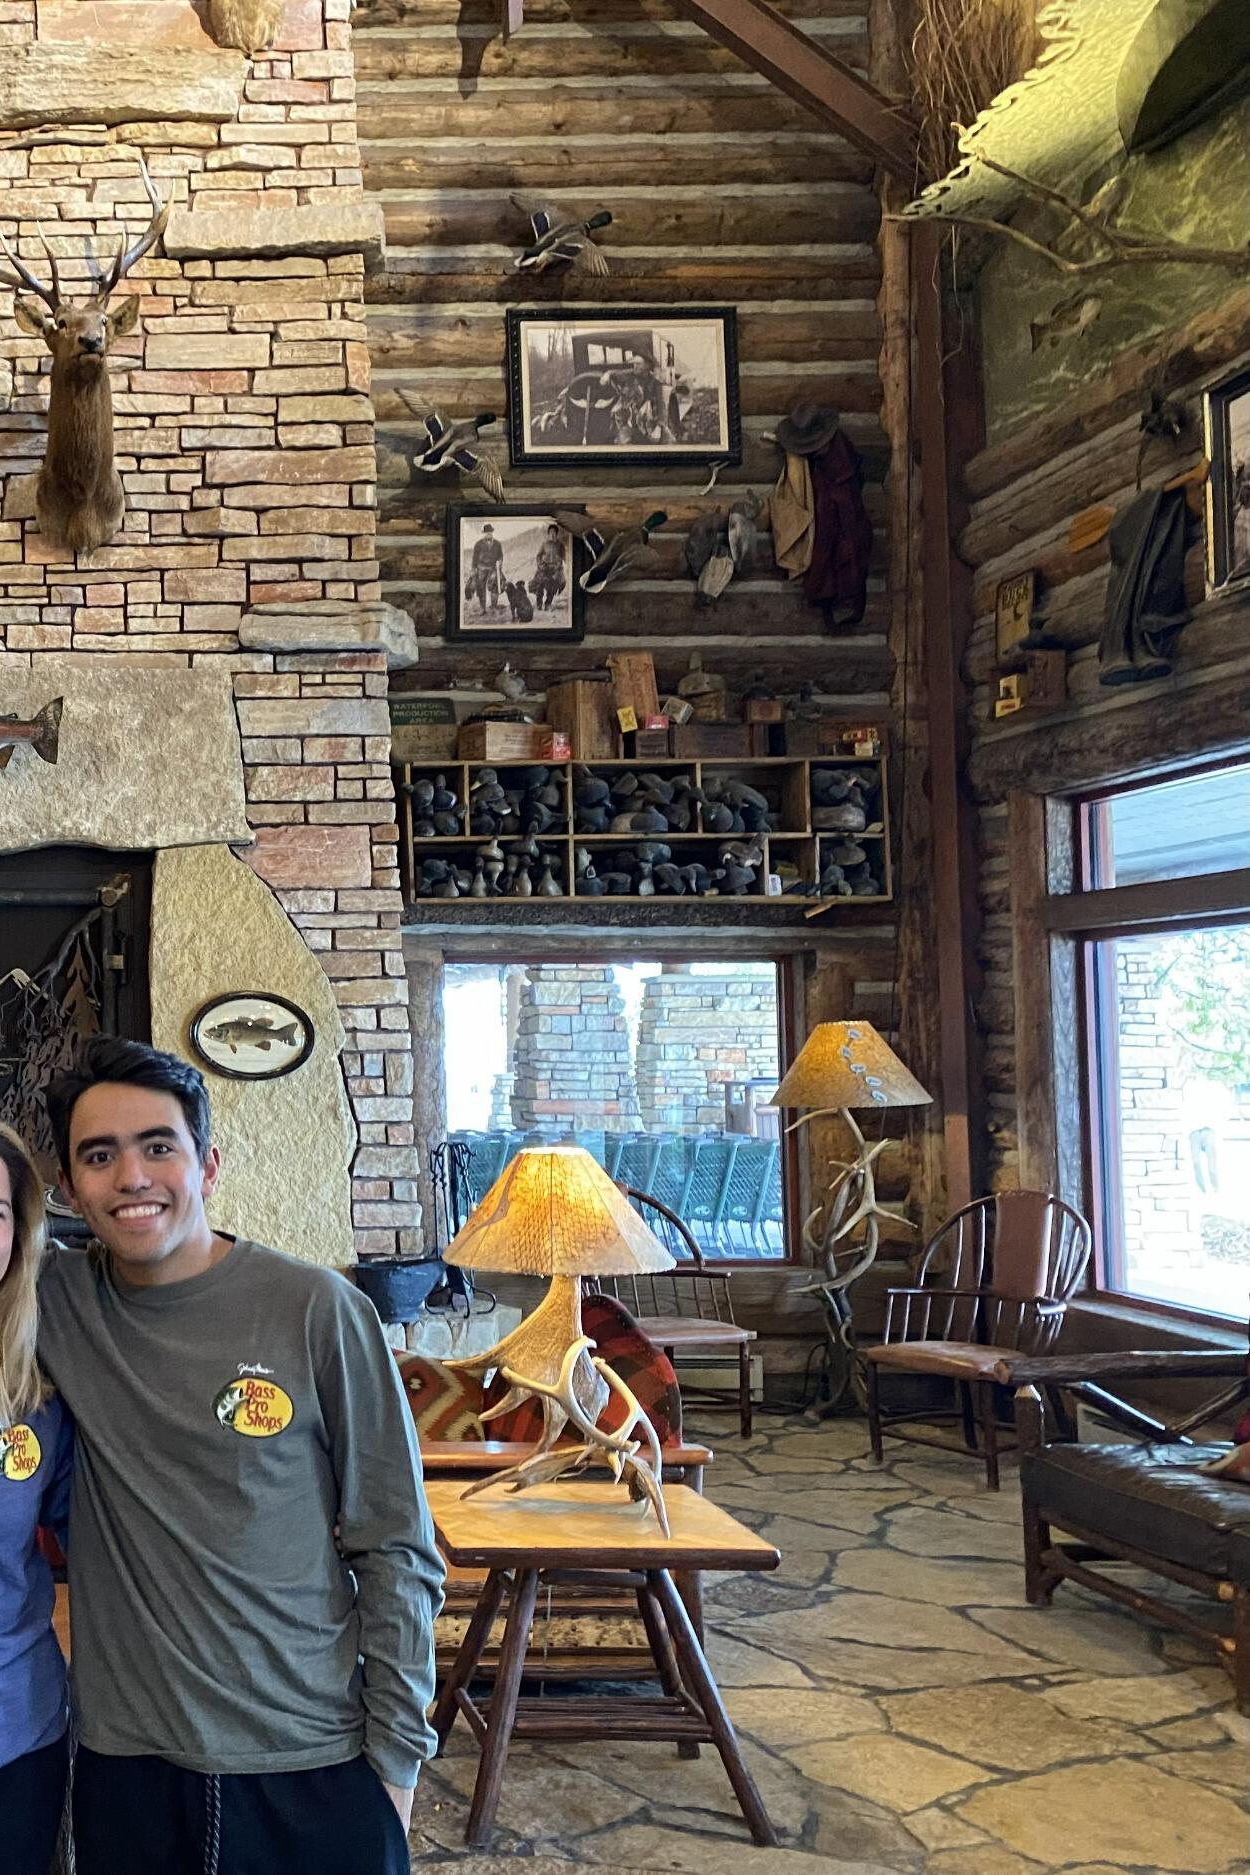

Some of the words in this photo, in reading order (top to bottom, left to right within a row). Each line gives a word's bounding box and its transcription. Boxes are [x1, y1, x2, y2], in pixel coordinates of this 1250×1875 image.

[245, 1380, 276, 1399] Bass
[244, 1396, 269, 1413] Pro
[244, 1410, 283, 1432] Shops
[7, 1429, 29, 1442] Bass
[12, 1441, 26, 1456] Pro
[12, 1456, 37, 1473] Shops
